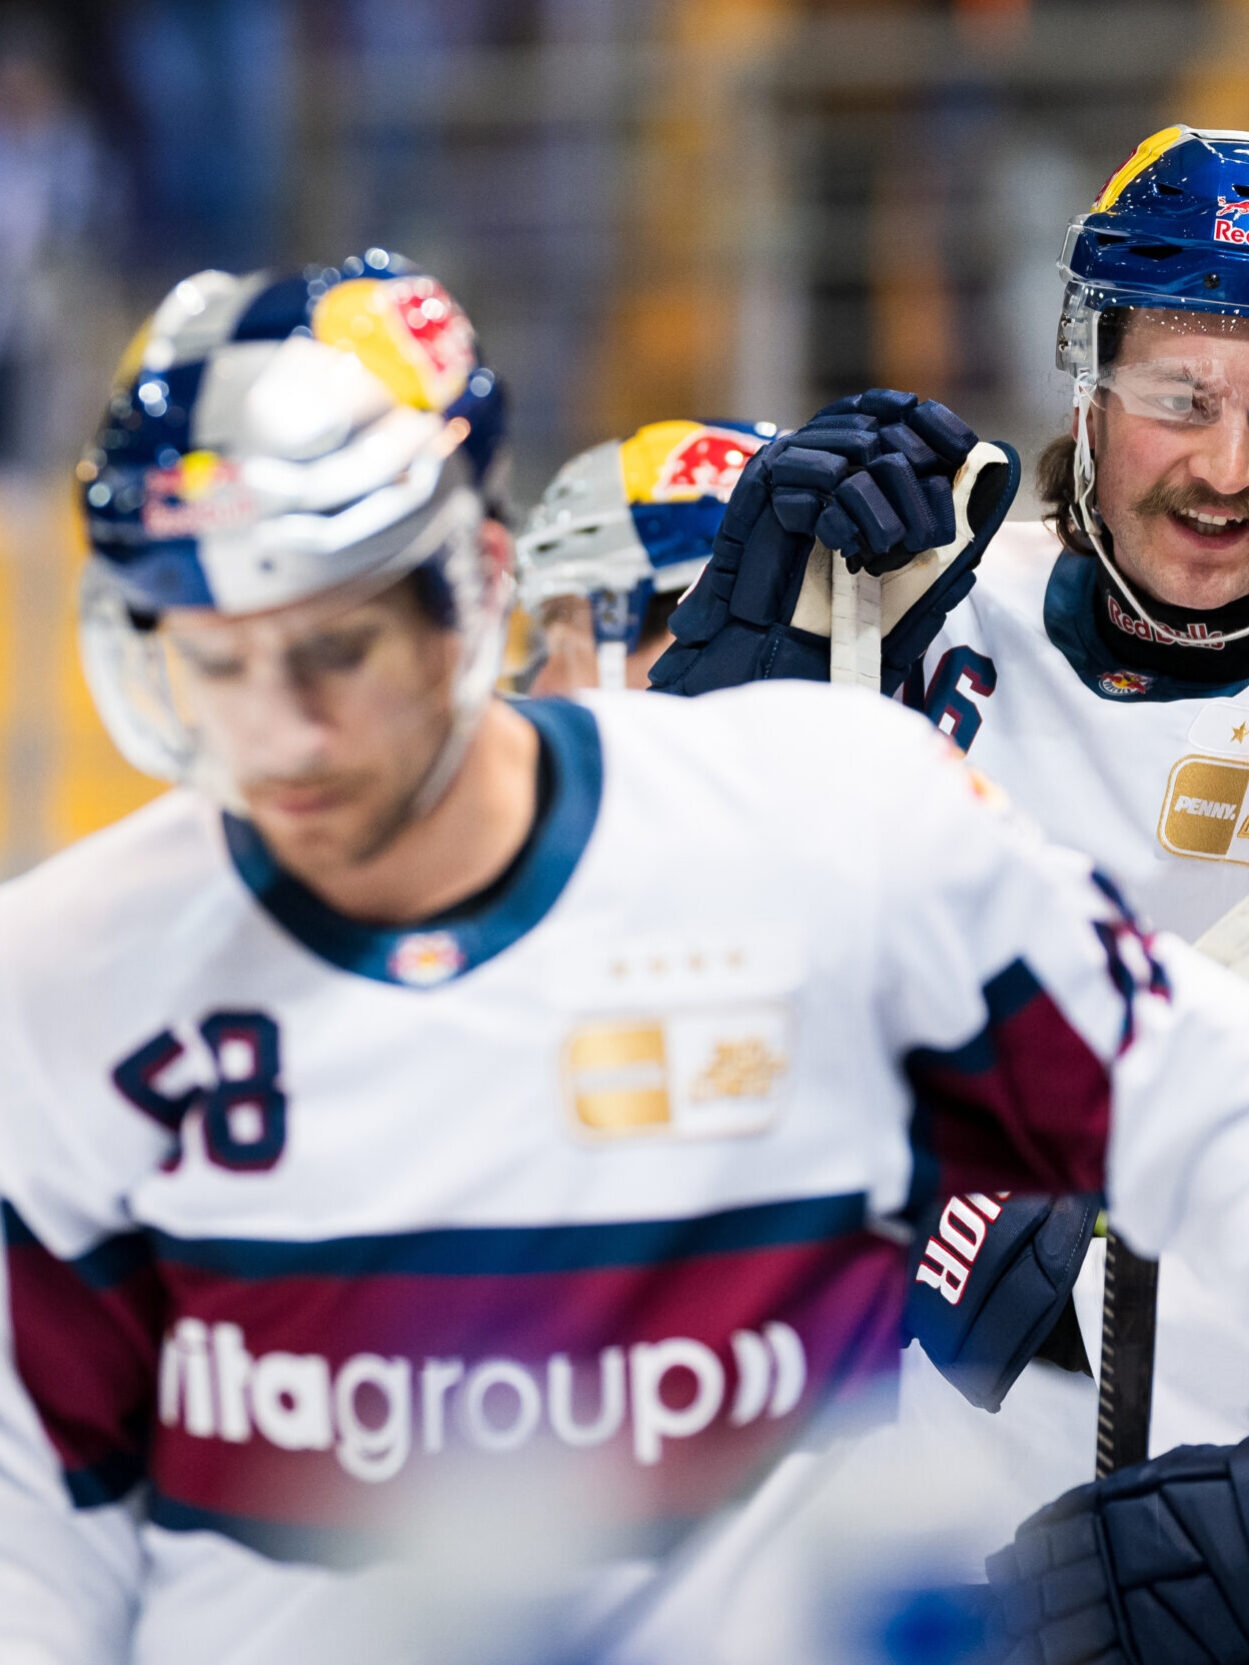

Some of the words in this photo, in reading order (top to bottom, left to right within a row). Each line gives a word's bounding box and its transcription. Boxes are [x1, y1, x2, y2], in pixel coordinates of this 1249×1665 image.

[1108, 595, 1154, 642] Red
[902, 645, 998, 756] 6
[915, 1190, 1011, 1306] IOR
